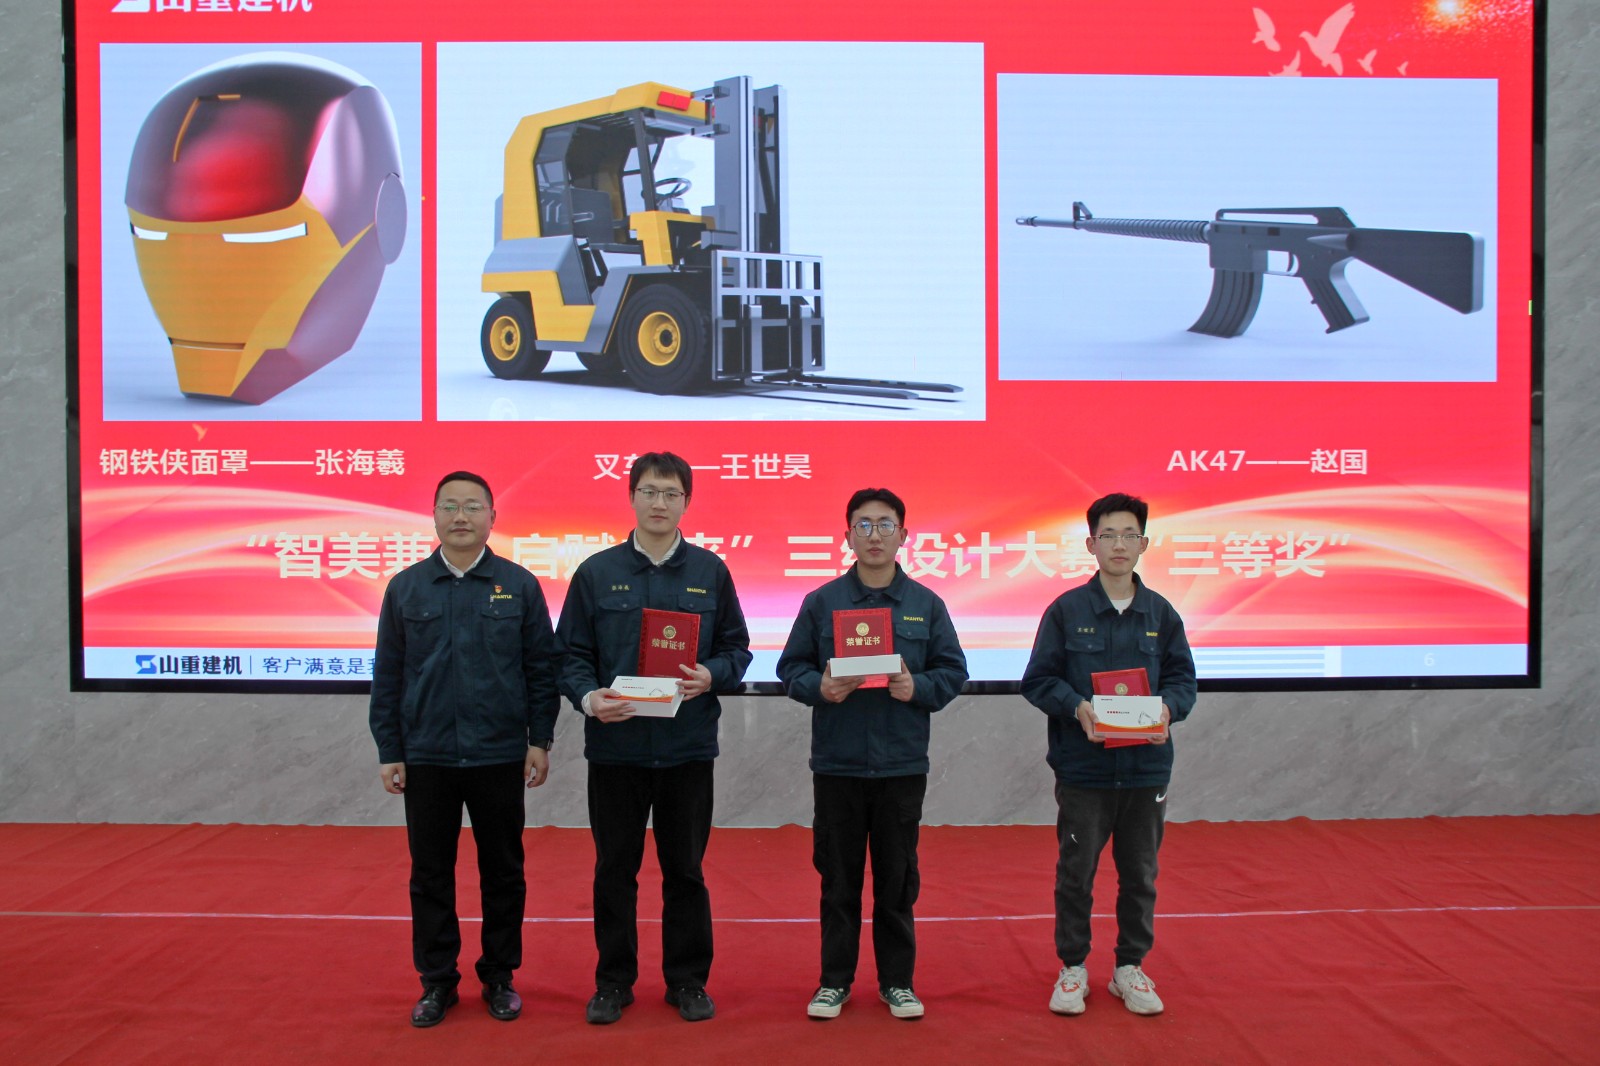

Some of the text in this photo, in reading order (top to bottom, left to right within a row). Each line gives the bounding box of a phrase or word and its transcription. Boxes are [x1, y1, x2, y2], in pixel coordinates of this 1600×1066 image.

[159, 654, 375, 676] 山重建机 客户满意是
